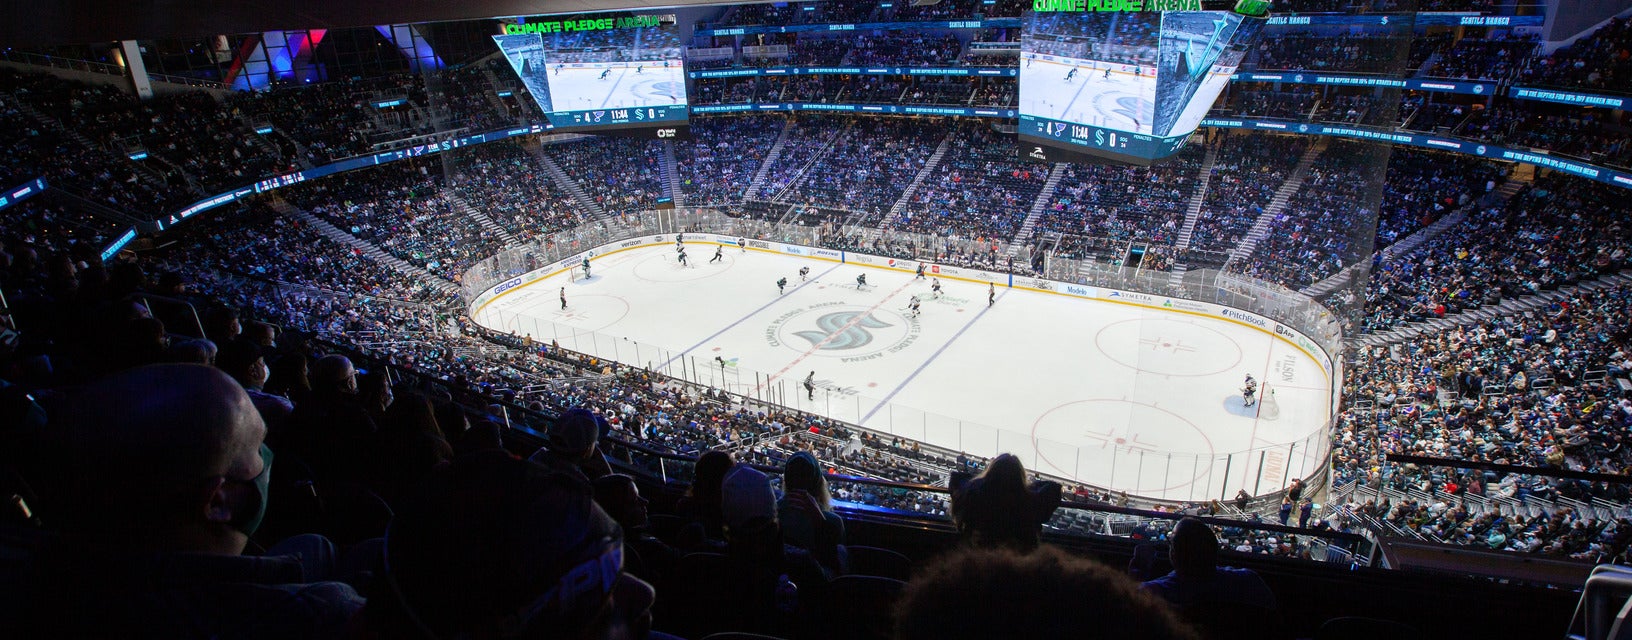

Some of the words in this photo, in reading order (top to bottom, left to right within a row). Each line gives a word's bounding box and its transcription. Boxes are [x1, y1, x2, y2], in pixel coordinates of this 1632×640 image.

[1033, 0, 1085, 12] CLIMATE
[1088, 0, 1143, 12] PLEDGE
[1145, 0, 1202, 11] ARENA
[507, 21, 561, 35] CLIMATE
[564, 18, 613, 31] PLEDGE
[616, 15, 660, 28] ARENA
[584, 113, 591, 122] 4
[611, 109, 629, 119] 11:44
[648, 108, 654, 119] 0
[1046, 121, 1052, 135] 4
[1072, 125, 1088, 140] 11:44
[1109, 132, 1116, 147] 0
[621, 239, 642, 248] verizon
[494, 277, 522, 295] GEICO
[1067, 285, 1087, 296] Modelo
[1121, 292, 1152, 301] SYMETRA
[1229, 311, 1266, 328] PitchBook
[1282, 355, 1297, 383] FILSON
